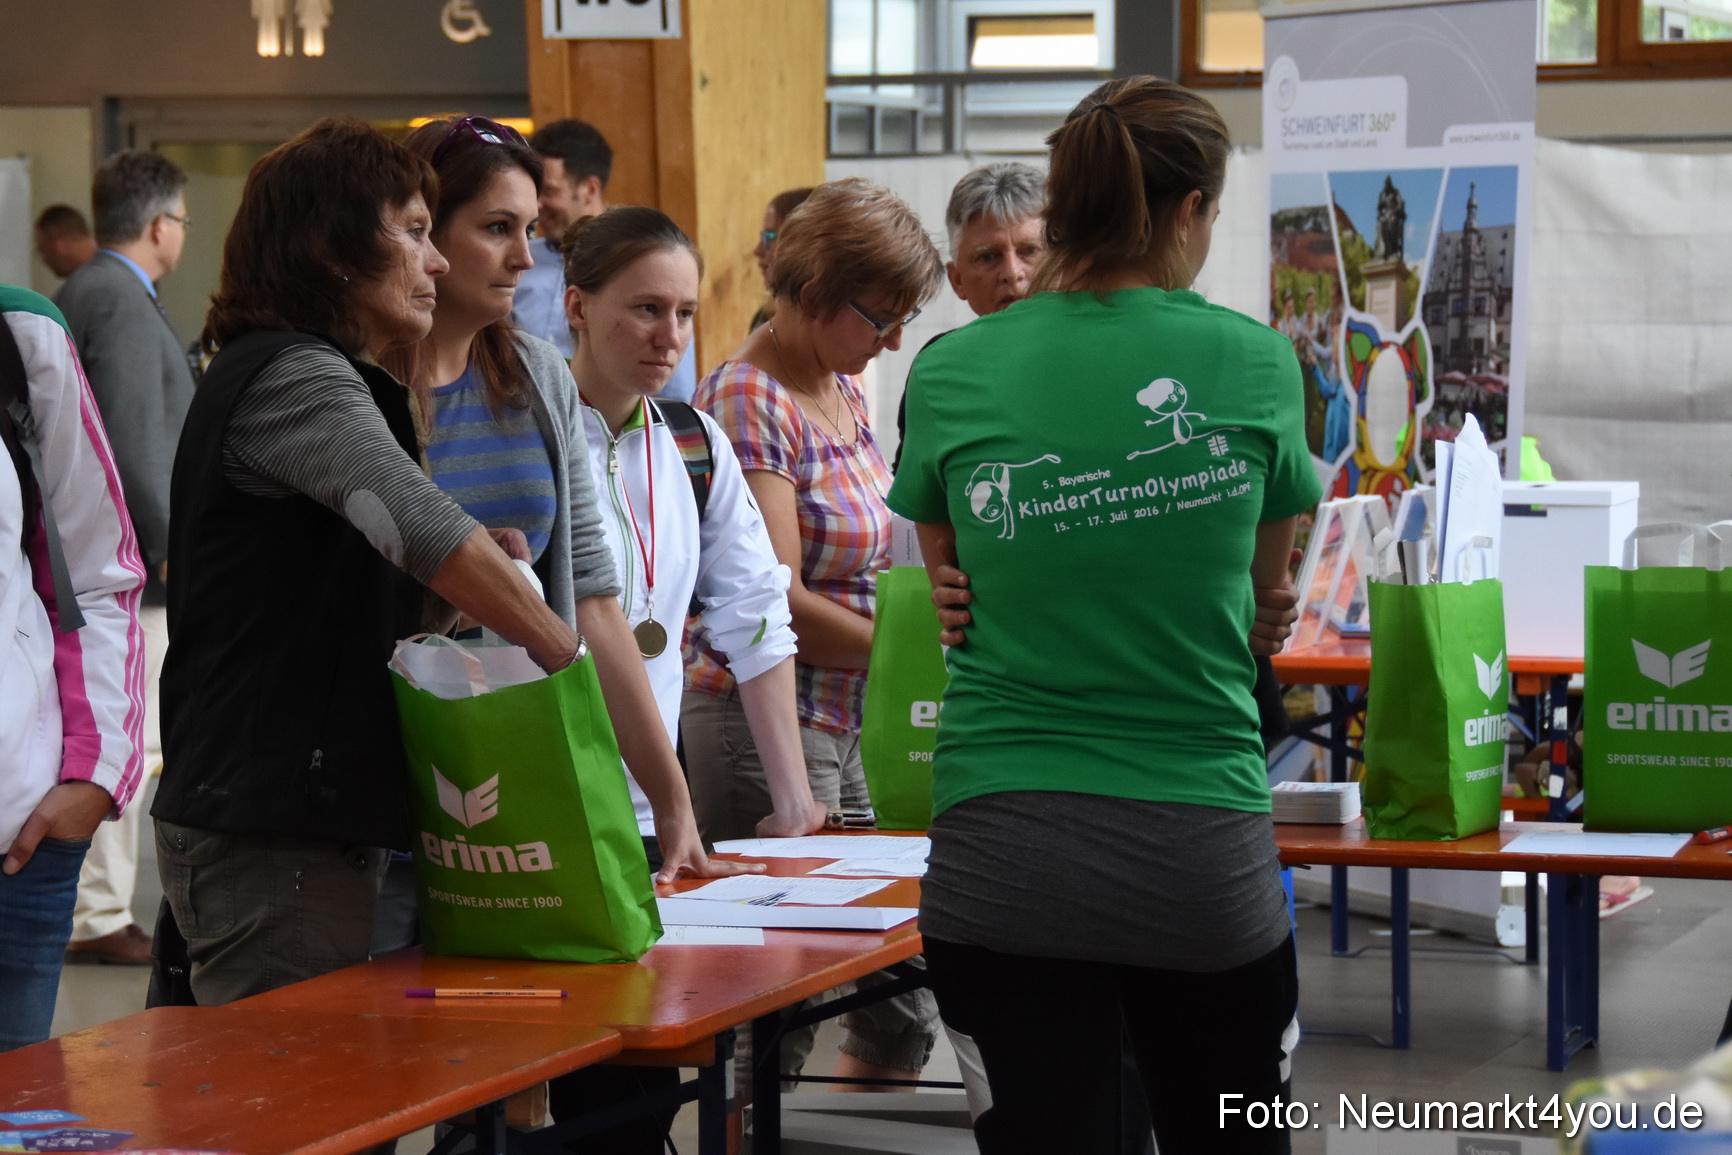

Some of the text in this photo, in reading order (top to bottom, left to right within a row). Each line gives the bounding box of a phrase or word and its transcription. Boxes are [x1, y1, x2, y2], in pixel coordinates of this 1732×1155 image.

[1281, 113, 1366, 137] SCHWEINFURT
[1018, 459, 1248, 519] KinderTurnOlympiade
[1043, 468, 1111, 489] 5. Bayerische
[1054, 522, 1071, 533] 15.
[1087, 516, 1104, 527] 17.
[1109, 510, 1128, 524] Juli
[1134, 505, 1160, 518] 2016
[1177, 492, 1222, 511] Neumarkt
[1464, 709, 1509, 747] erima
[1607, 696, 1732, 732] erima
[1607, 753, 1677, 767] SPORTSWEAR
[1679, 756, 1712, 768] SINCE
[421, 831, 553, 873] erima
[428, 887, 563, 909] SPORTSWEAR SINCE 1900
